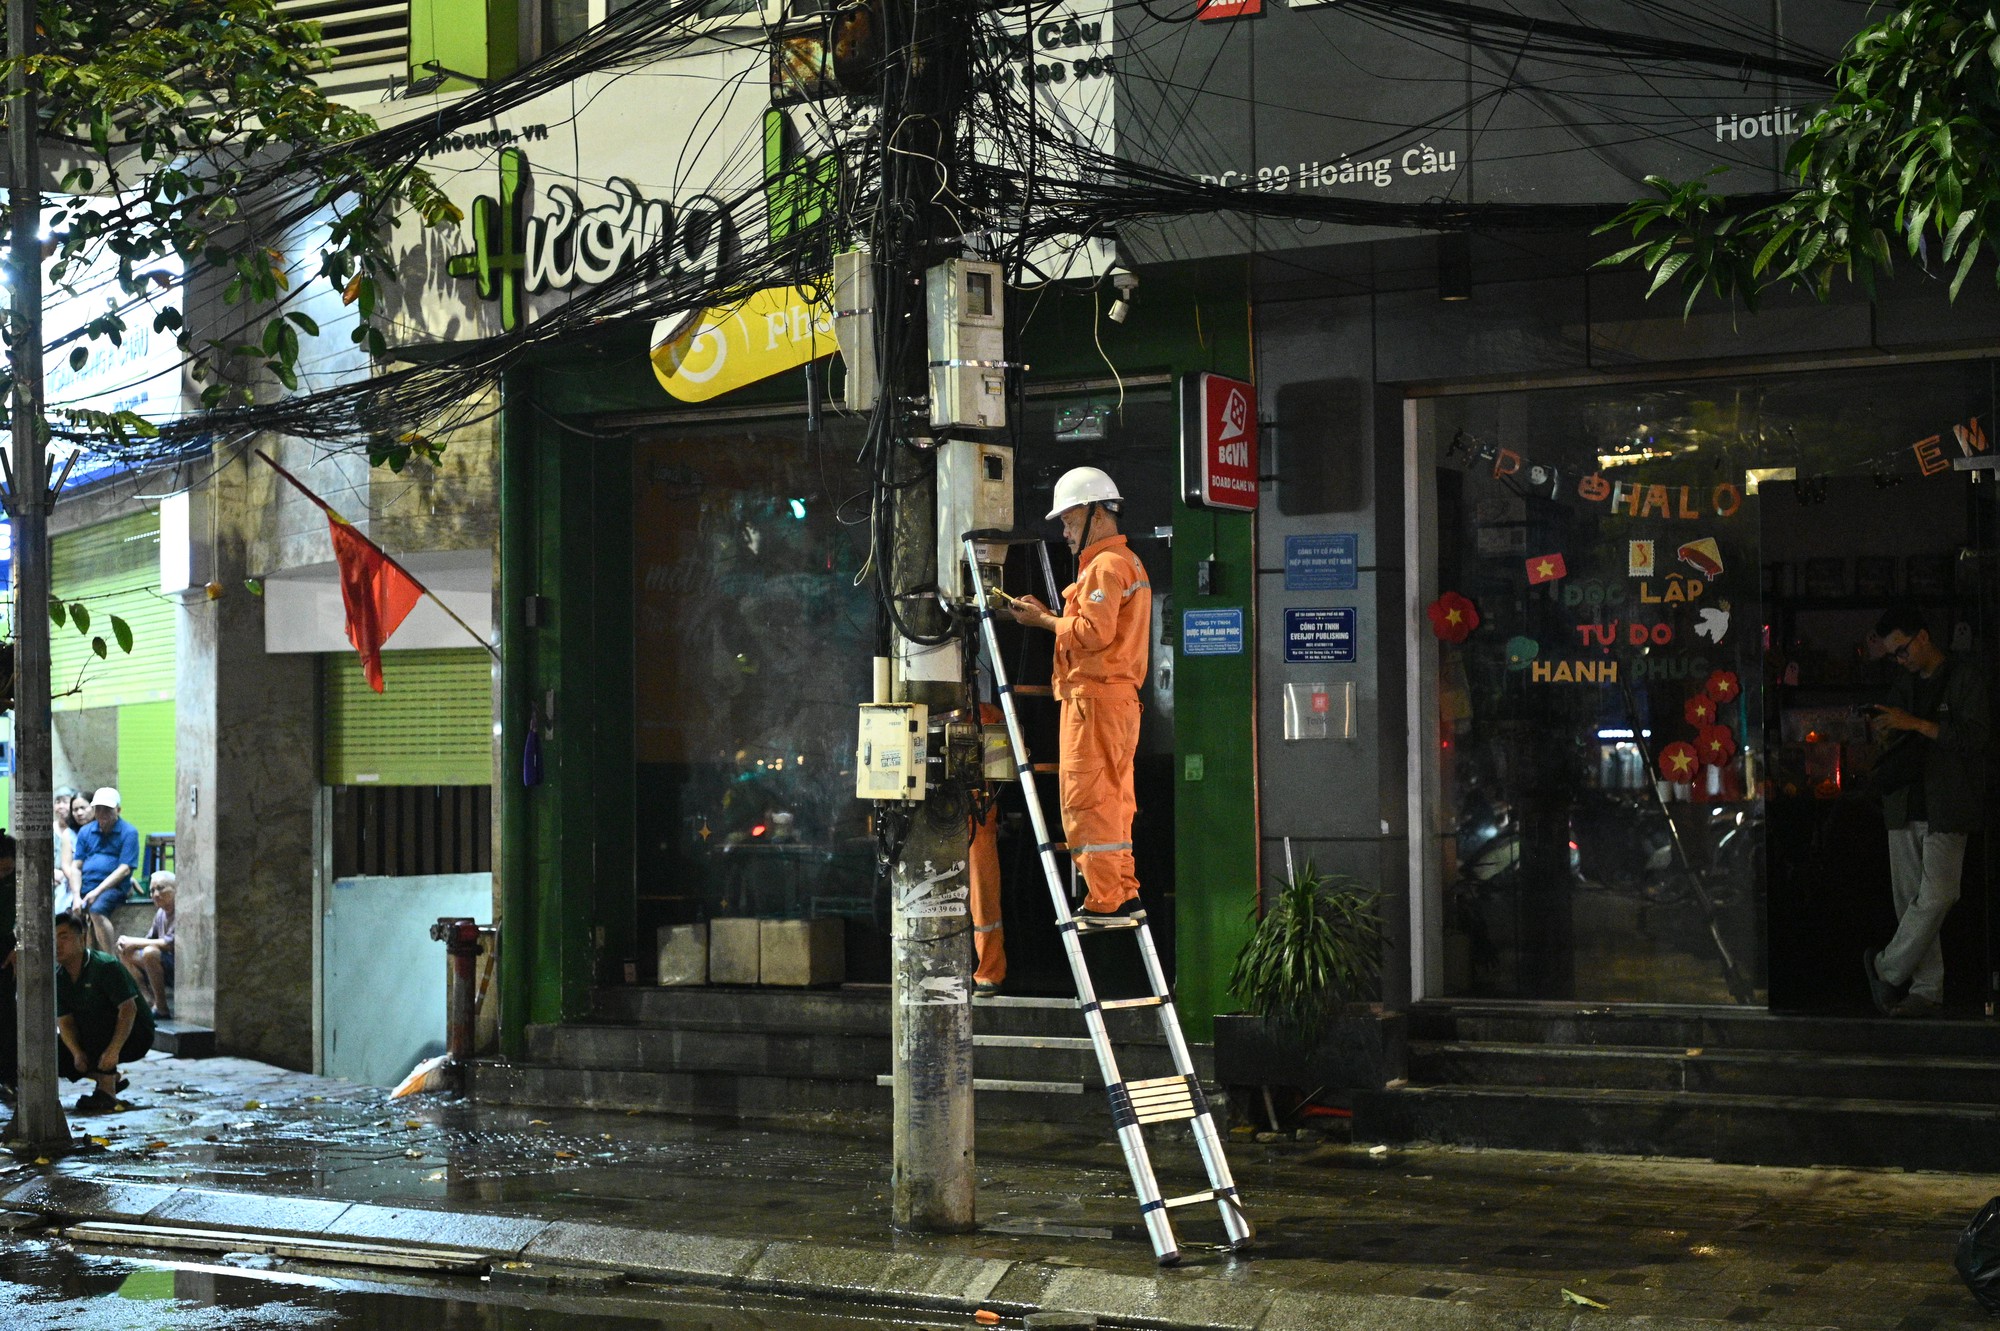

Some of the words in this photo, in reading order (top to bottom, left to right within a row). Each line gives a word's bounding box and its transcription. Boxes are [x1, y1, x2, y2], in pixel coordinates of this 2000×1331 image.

[1257, 165, 1290, 192] 89
[1401, 143, 1456, 176] Cầu
[1218, 441, 1248, 468] BGVN
[1211, 475, 1231, 489] BOARD
[1231, 478, 1247, 491] GAME
[1297, 547, 1312, 555] CÔNG
[1640, 572, 1704, 608] LẬP
[1300, 622, 1315, 630] CÔNG
[1315, 632, 1349, 640] PUBLISHING
[1576, 617, 1620, 654] TỰ
[1629, 622, 1672, 645] DO
